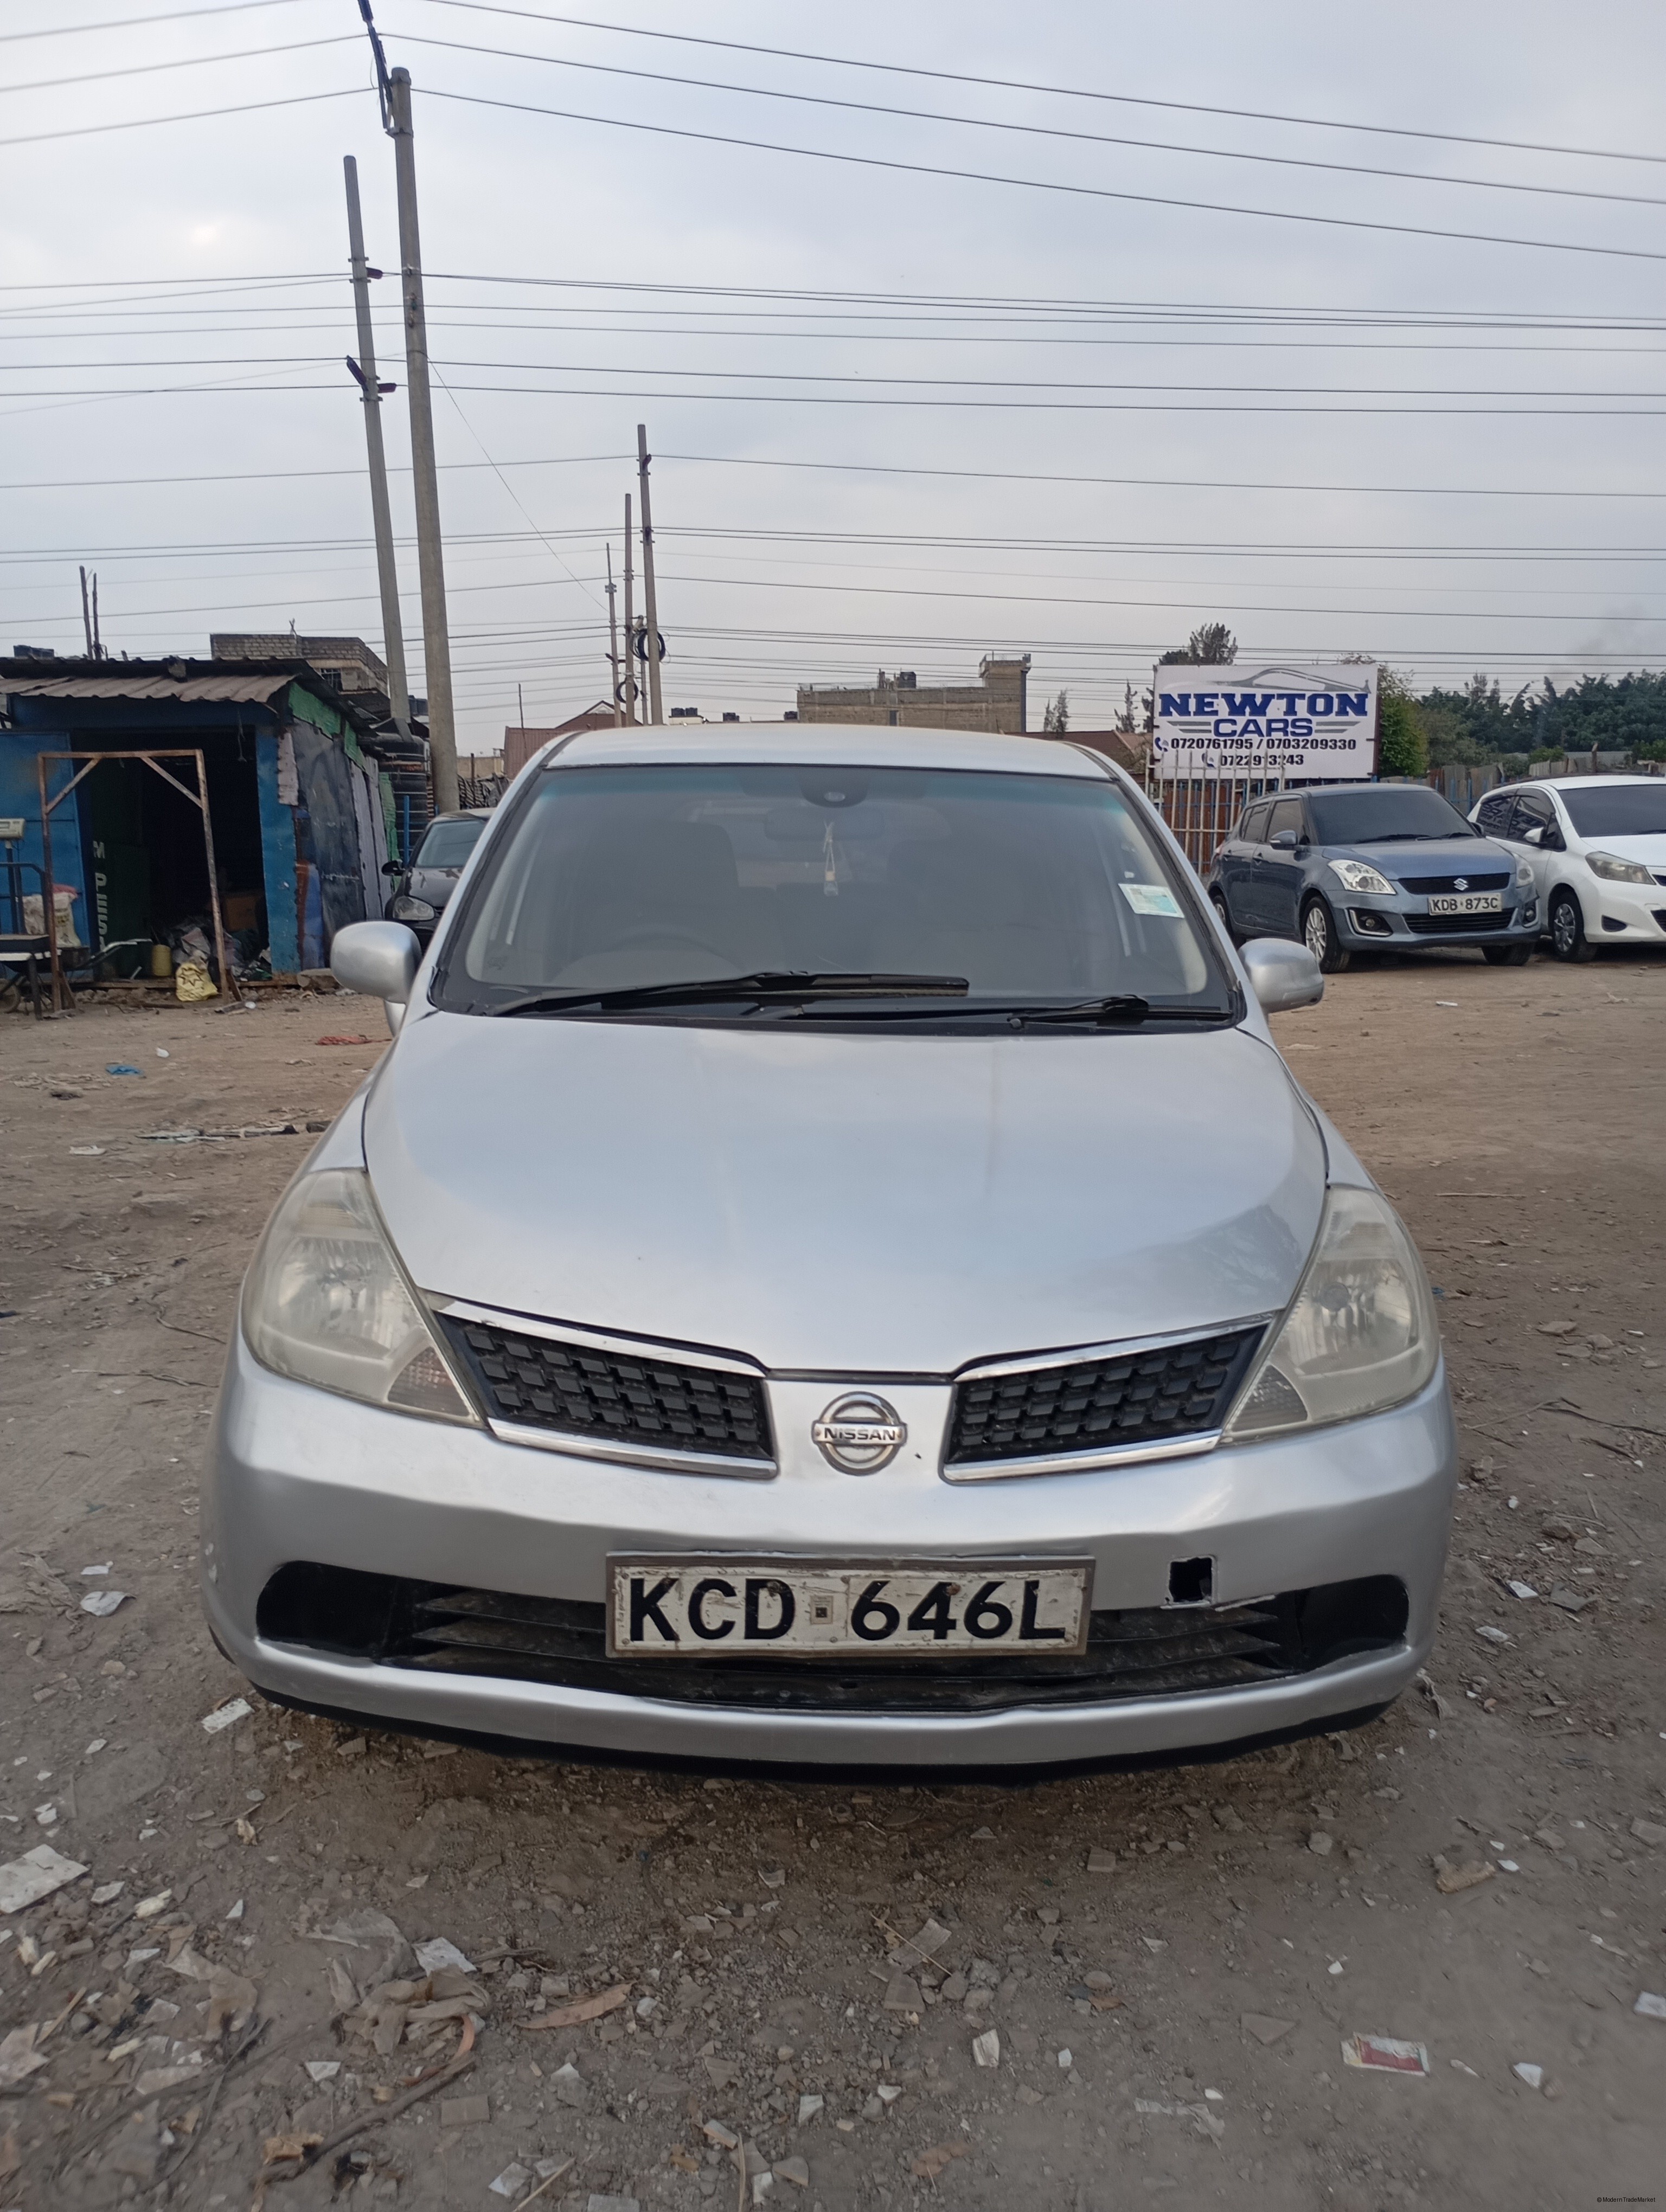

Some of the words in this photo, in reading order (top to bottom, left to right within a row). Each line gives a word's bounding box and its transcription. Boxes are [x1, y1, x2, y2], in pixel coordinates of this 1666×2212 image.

[1158, 693, 1368, 717] NEWTON
[1213, 718, 1313, 737] CARS
[1171, 738, 1253, 749] 0720761795
[1266, 738, 1356, 750] 0703209330
[1220, 754, 1304, 766] 072293243
[1432, 898, 1458, 911] KDB
[1465, 897, 1498, 910] 873C
[824, 1427, 895, 1441] NISSAN
[629, 1577, 796, 1642] KCD
[850, 1580, 1067, 1641] 646L
